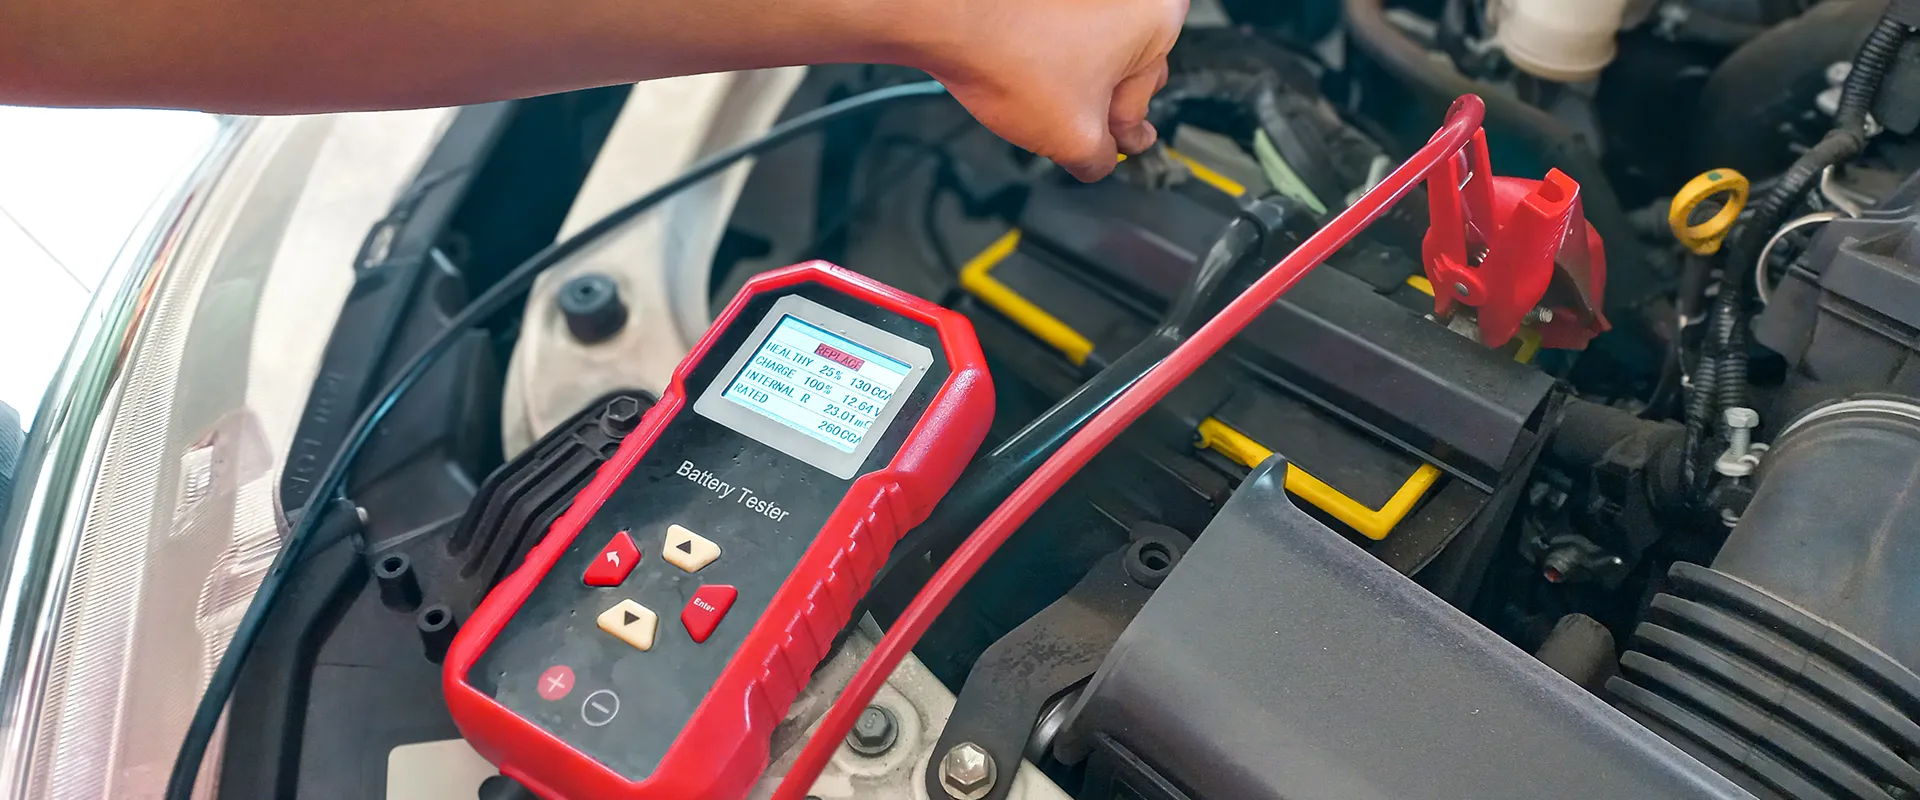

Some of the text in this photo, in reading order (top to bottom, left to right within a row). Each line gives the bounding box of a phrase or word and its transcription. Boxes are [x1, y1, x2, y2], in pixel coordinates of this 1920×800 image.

[766, 342, 814, 367] HEALTHY
[819, 365, 843, 380] 25%
[815, 345, 863, 371] REPLACE
[745, 370, 795, 398] INTERNAL
[800, 393, 810, 403] R
[755, 356, 797, 378] CHARGE
[804, 377, 833, 394] 100%
[733, 383, 769, 404] RATED
[676, 460, 790, 522] Battery Tester
[693, 597, 715, 612] Enter
